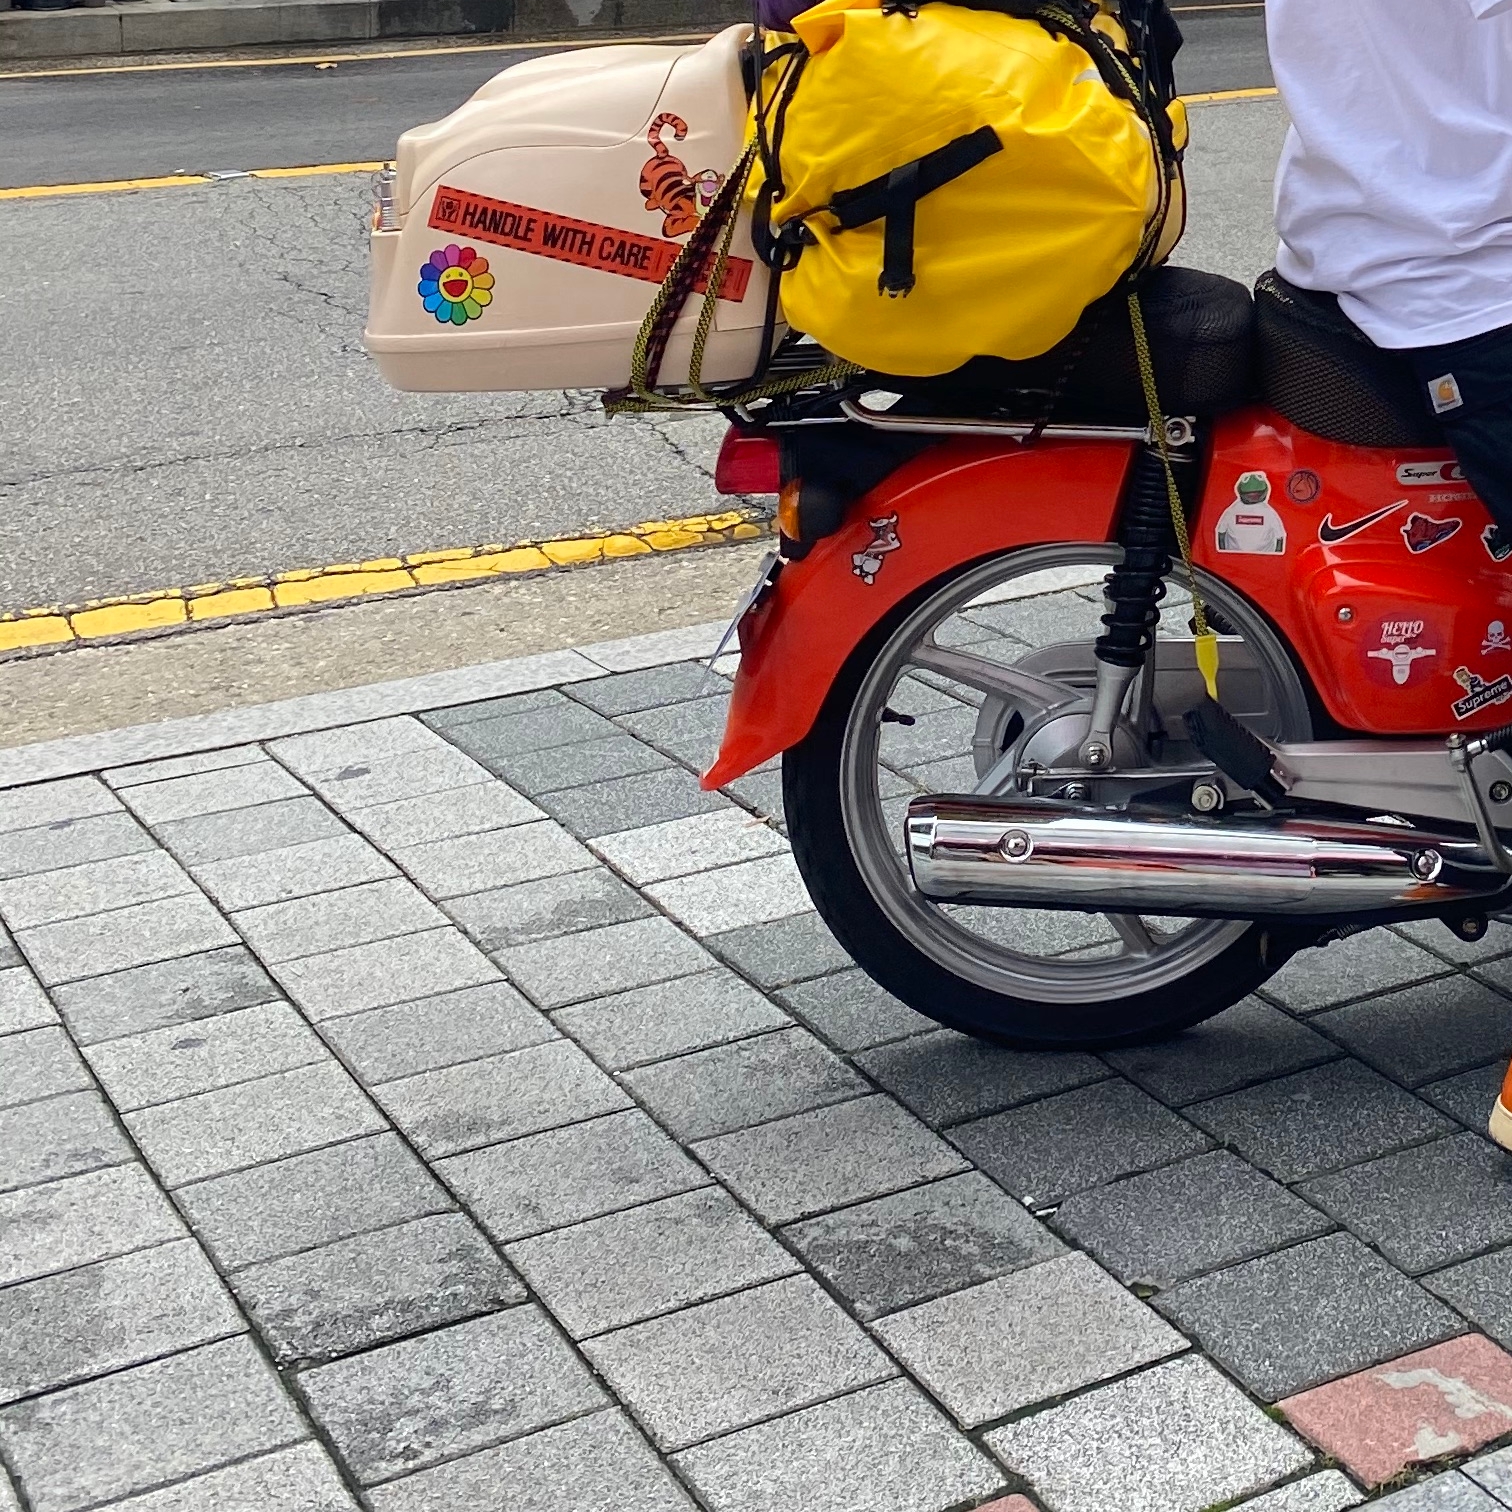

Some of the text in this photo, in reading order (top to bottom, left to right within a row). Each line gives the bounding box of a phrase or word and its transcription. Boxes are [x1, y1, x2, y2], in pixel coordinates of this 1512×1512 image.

[461, 201, 537, 243] HANDLE
[542, 220, 597, 259] WITH
[599, 236, 656, 272] CARE
[1401, 468, 1438, 479] Super
[1458, 681, 1508, 713] Supreme
